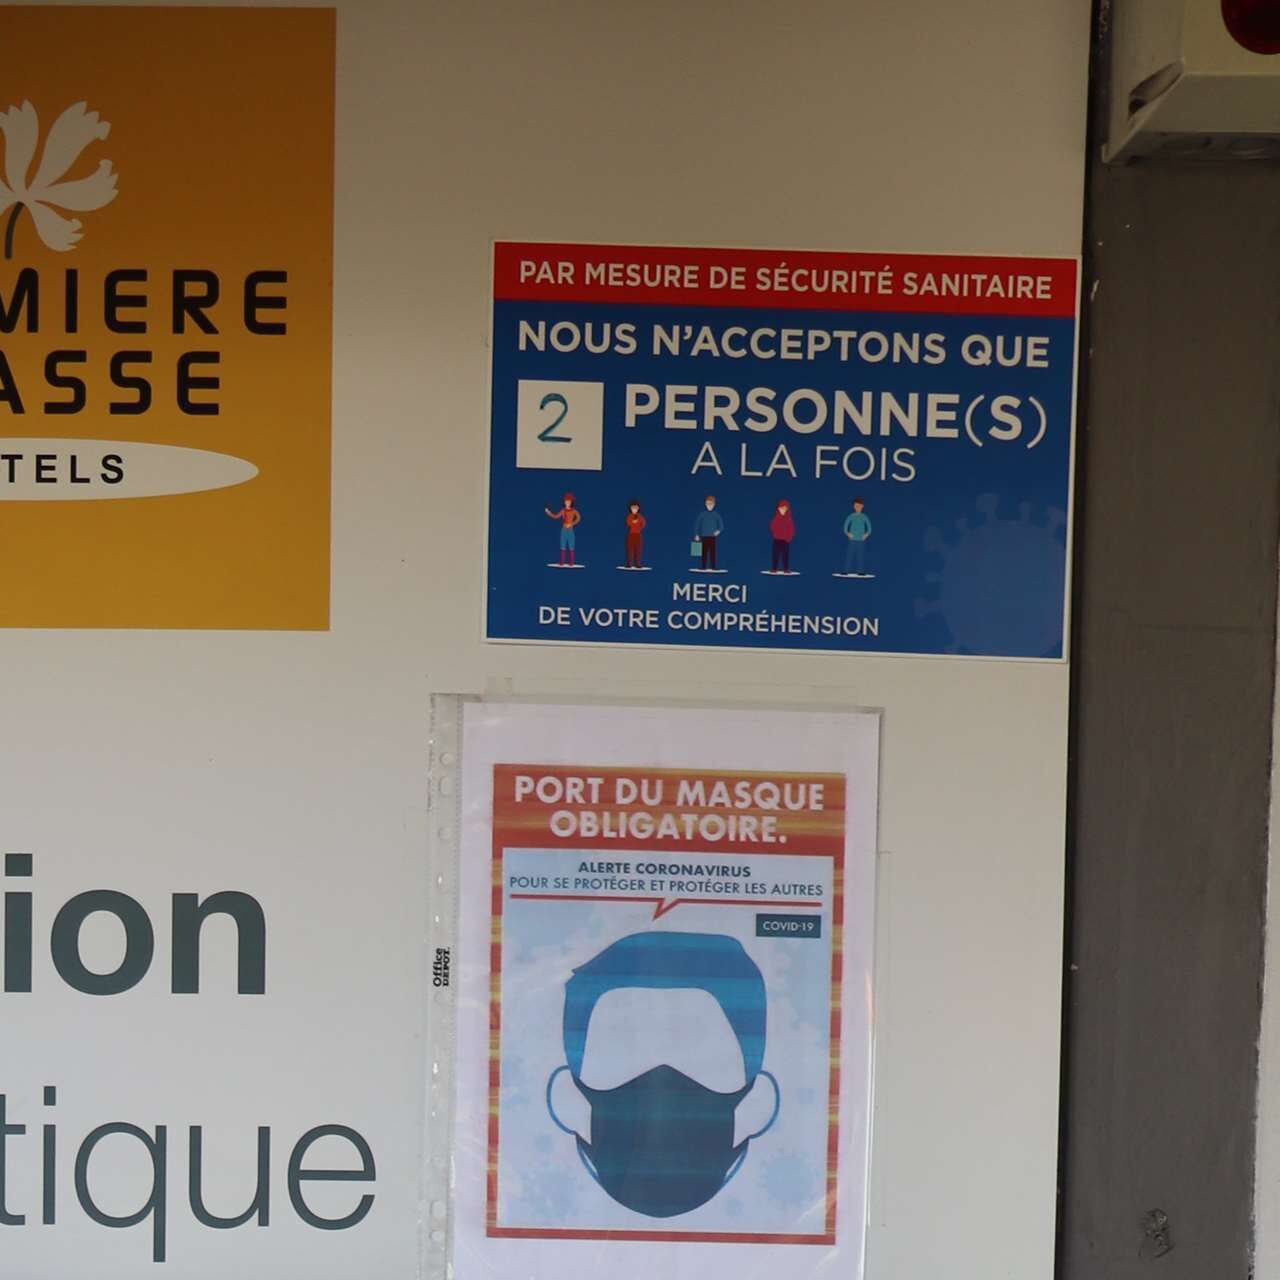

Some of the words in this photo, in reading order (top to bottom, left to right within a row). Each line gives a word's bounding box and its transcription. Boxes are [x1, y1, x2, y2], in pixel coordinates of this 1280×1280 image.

[520, 261, 574, 284] PAR
[585, 263, 699, 288] MESURE
[710, 266, 746, 289] DE
[756, 265, 893, 294] SÉCURITÉ
[903, 272, 1052, 299] SANITAIRE
[519, 321, 636, 354] NOUS
[653, 325, 945, 364] N'ACCEPTONS
[962, 334, 1049, 367] QUE
[537, 392, 574, 444] 2
[625, 384, 1046, 448] PERSONNE(S)
[691, 442, 722, 475] A
[741, 443, 797, 477] LA
[816, 446, 915, 481] FOIS
[673, 583, 746, 603] MERCI
[539, 606, 570, 624] DE
[579, 608, 659, 628] VOTRE
[668, 610, 878, 635] COMPRÉHENSION
[515, 776, 603, 804] PORT
[616, 778, 662, 806] DU
[677, 780, 824, 810] MASQUE
[550, 809, 787, 843] OBLIGATOIRE.
[510, 876, 548, 888] POUR
[554, 877, 569, 888] SE
[574, 876, 645, 890] PROTÉGER
[650, 880, 665, 891] ET
[670, 879, 740, 893] PROTÉGER
[745, 883, 767, 894] LES
[771, 884, 823, 896] AUTRES
[578, 862, 630, 873] ALERTE
[636, 863, 751, 877] CORONAVIRUS
[763, 921, 814, 931] COVID-19
[433, 947, 442, 987] Office
